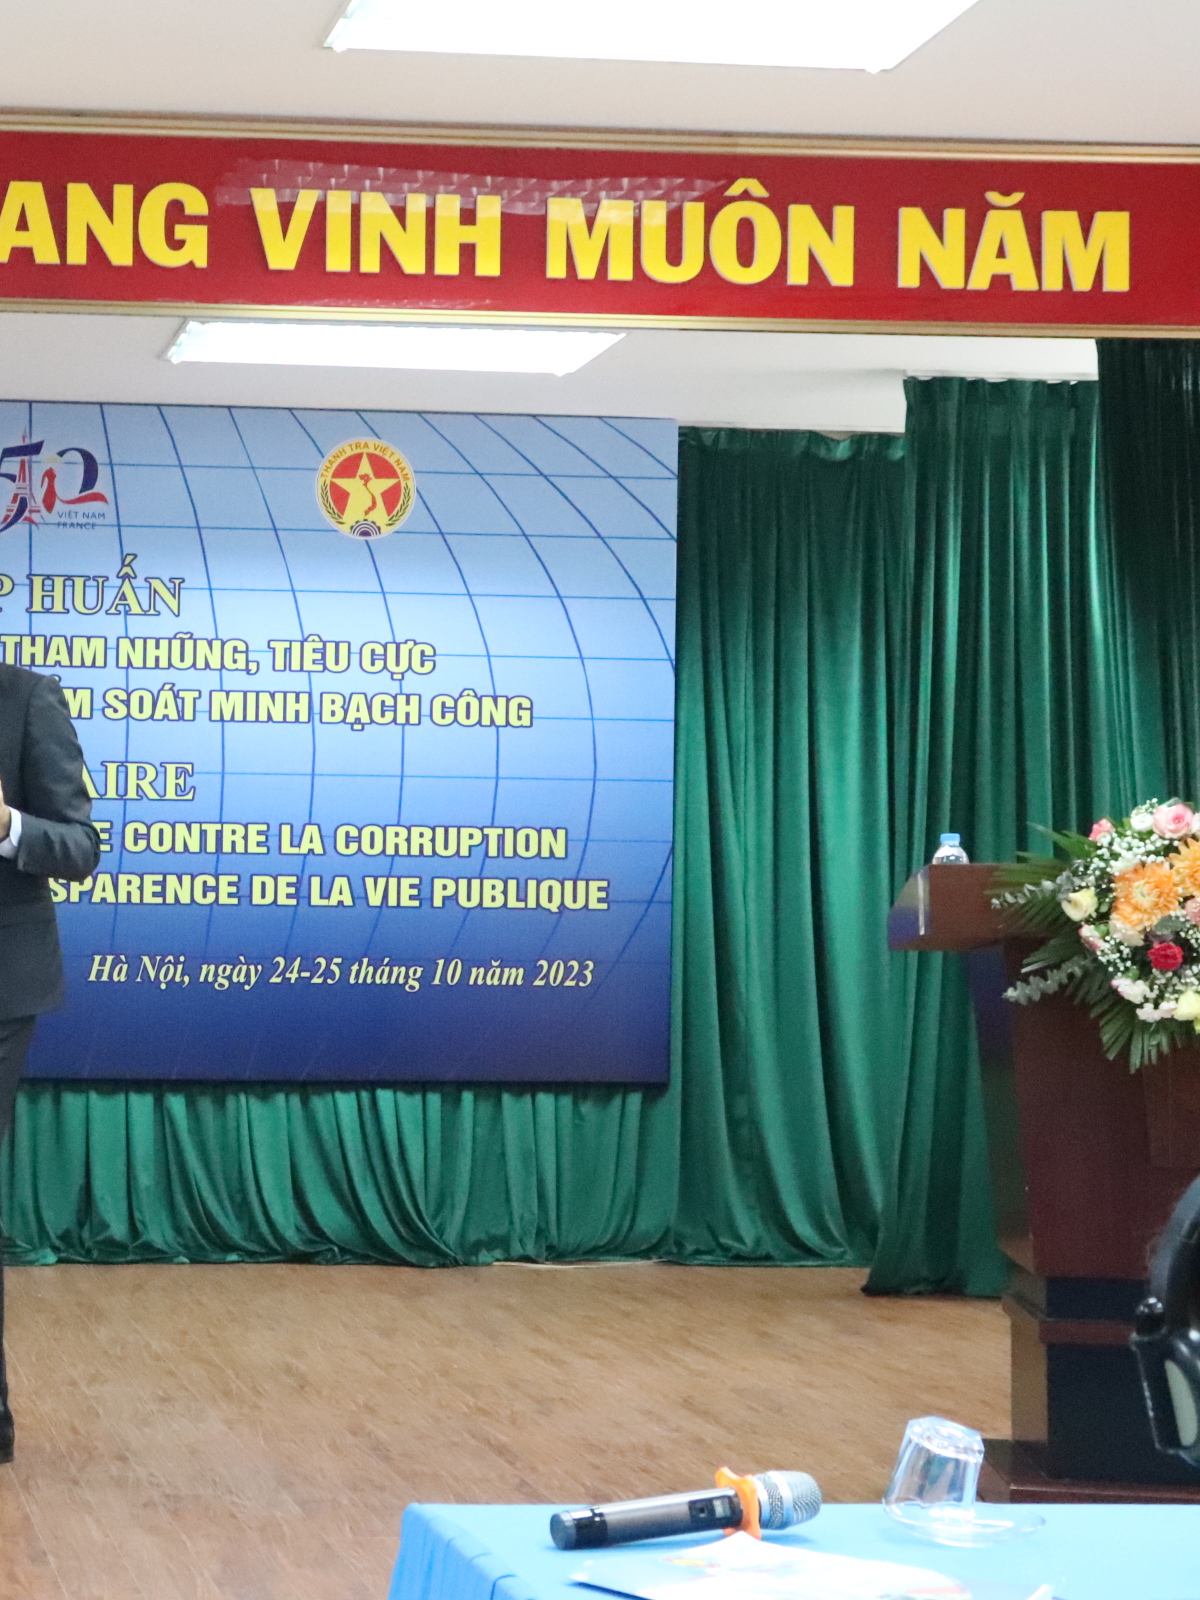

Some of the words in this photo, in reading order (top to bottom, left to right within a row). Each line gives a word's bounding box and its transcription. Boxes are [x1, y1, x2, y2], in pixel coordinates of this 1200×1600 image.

[250, 187, 502, 277] VINH
[546, 177, 855, 287] MUÔN
[897, 191, 1130, 292] NĂM
[321, 447, 347, 478] THANH
[348, 441, 369, 452] TRA
[394, 459, 410, 481] NAM
[57, 522, 97, 530] FRANCE
[83, 511, 105, 519] NAM
[26, 553, 185, 617] HUẤN
[116, 632, 259, 676] NHŨNG,
[269, 634, 351, 674] TIÊU
[360, 640, 437, 681] CỰC
[102, 683, 200, 722] SOÁT
[210, 689, 310, 724] MINH
[320, 691, 421, 731] BẠCH
[430, 689, 533, 729] CÔNG
[122, 820, 269, 856] CONTRE
[280, 823, 325, 857] LA
[334, 824, 568, 859] CORRUPTION
[48, 872, 239, 906] SPARENCE
[250, 873, 299, 907] DE
[310, 875, 354, 908] LA
[364, 876, 421, 909] VIE
[431, 876, 609, 914] PUBLIQUE
[88, 954, 129, 983] Hà
[135, 955, 190, 990] Nội,
[199, 956, 262, 991] ngày
[269, 956, 343, 984] 24-25
[349, 957, 423, 993] tháng
[431, 958, 463, 986] 10
[469, 959, 524, 987] năm
[533, 959, 595, 987] 2023
